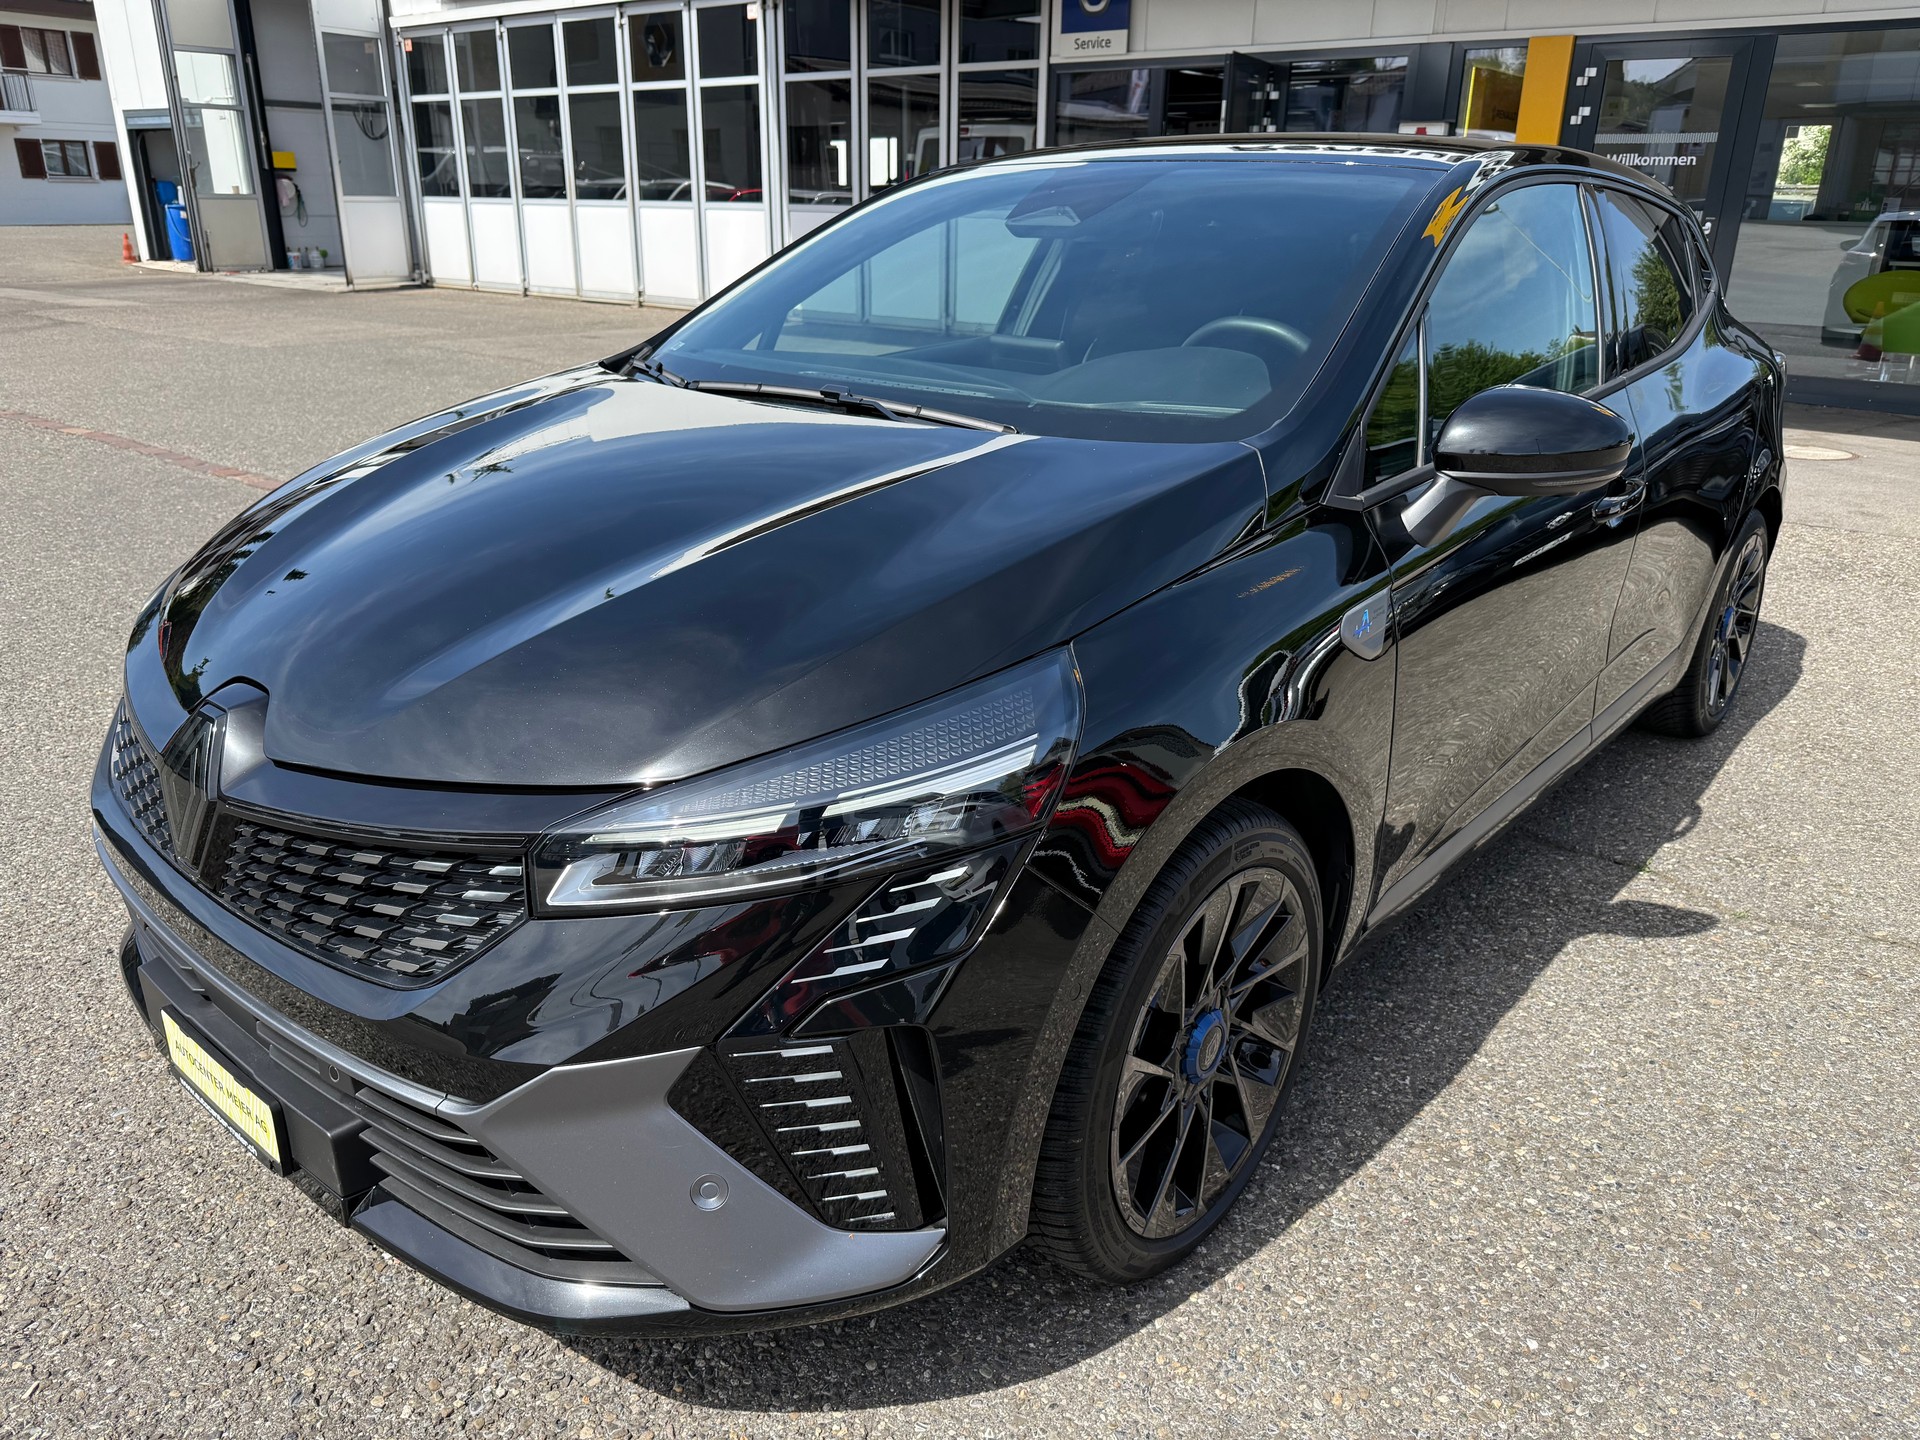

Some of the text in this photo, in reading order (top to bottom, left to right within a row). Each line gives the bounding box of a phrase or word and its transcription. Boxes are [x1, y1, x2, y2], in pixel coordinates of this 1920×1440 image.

[1074, 36, 1112, 50] Service
[1606, 153, 1697, 166] Willkommen
[175, 1040, 268, 1134] AUTOCENTER MEIER AG
